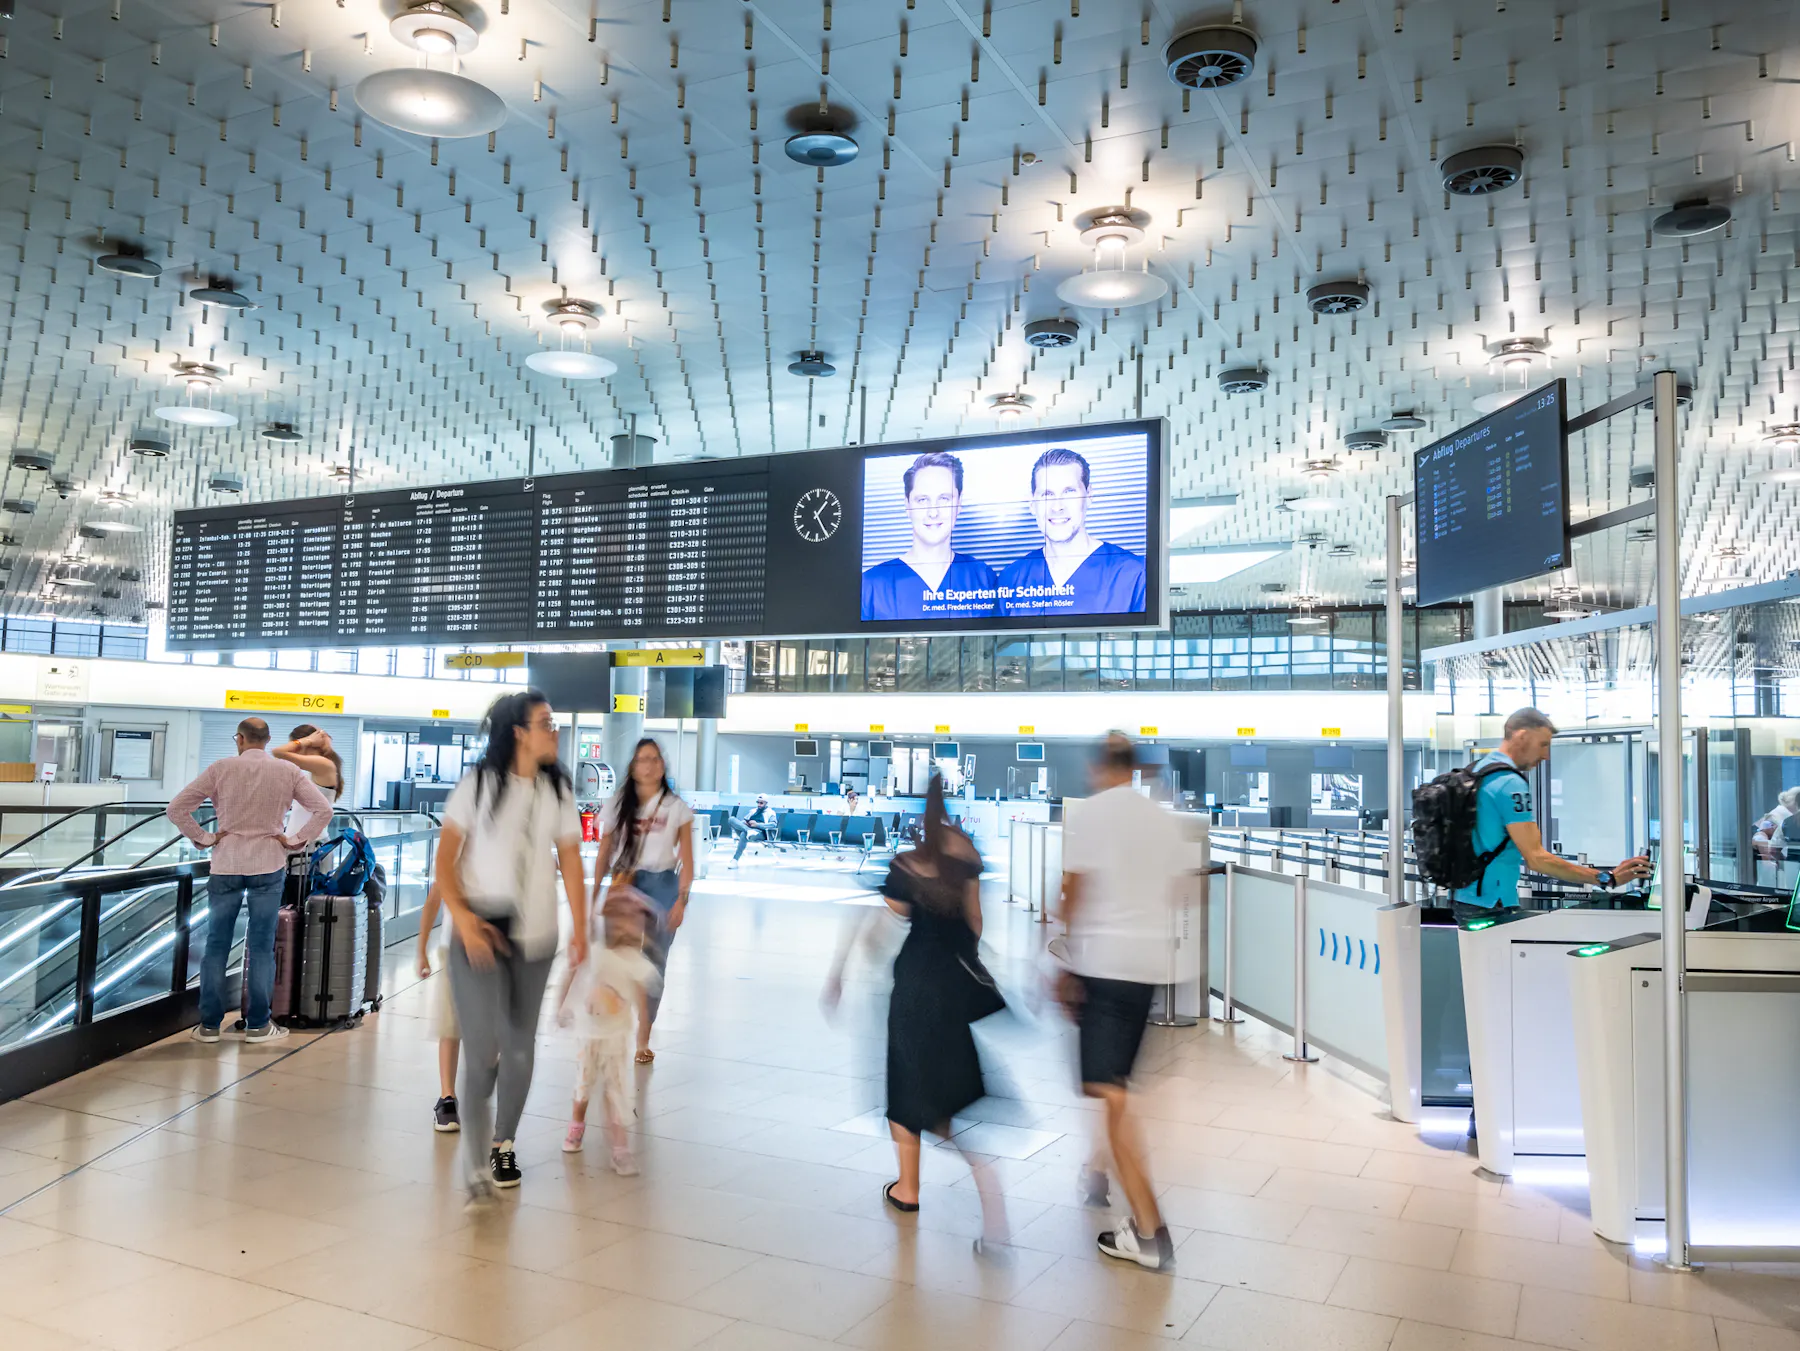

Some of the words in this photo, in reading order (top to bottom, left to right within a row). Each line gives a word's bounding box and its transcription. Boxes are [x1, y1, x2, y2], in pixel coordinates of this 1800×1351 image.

[1433, 443, 1454, 461] Abflug
[1455, 426, 1490, 450] Departures
[410, 492, 428, 501] Abflug
[430, 490, 434, 500] /
[436, 488, 464, 500] Departure
[670, 497, 701, 506] C301-304
[573, 515, 598, 524] Antalya
[670, 508, 700, 517] C323-328
[669, 530, 700, 538] C310-313
[572, 546, 596, 555] Antalya
[669, 540, 699, 549] C323-328
[668, 551, 699, 560] C319-322
[571, 567, 596, 576] Antalya
[570, 578, 595, 586] Antalya
[667, 584, 697, 592] A105-107
[922, 590, 943, 601] Ihre
[946, 588, 996, 602] Experten
[997, 588, 1014, 598] für
[1016, 584, 1074, 598] Schönheit
[570, 599, 594, 607] Antalya
[569, 620, 593, 628] Antalya
[656, 652, 664, 663] A
[302, 698, 325, 708] B/C
[1512, 793, 1532, 812] 32
